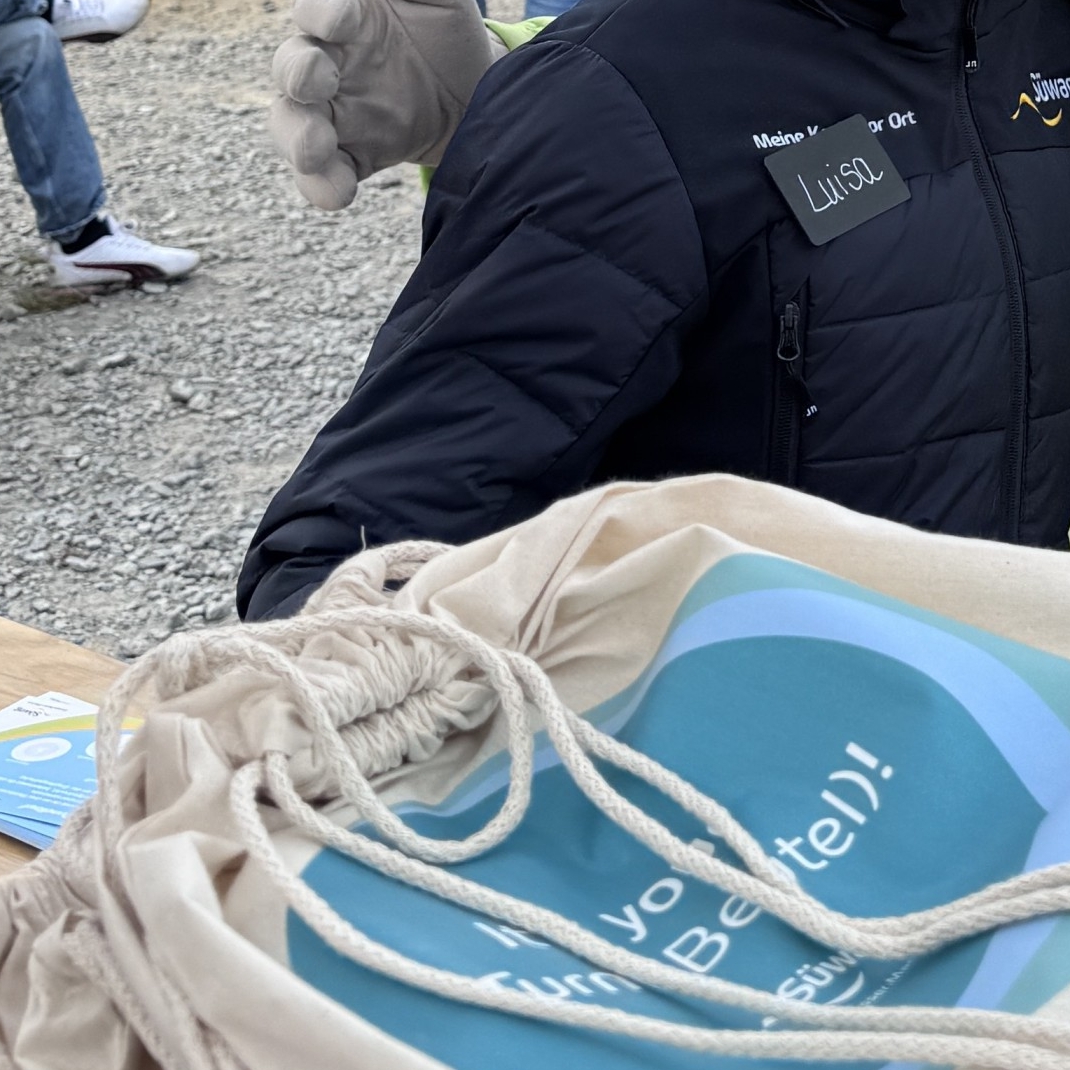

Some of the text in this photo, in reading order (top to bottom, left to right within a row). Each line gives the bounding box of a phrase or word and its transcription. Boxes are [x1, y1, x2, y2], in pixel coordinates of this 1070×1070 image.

[867, 119, 884, 133] or
[888, 111, 917, 129] Ort
[797, 157, 884, 212] Luisa
[662, 741, 894, 973] Betel)!
[776, 949, 866, 1003] Süw
